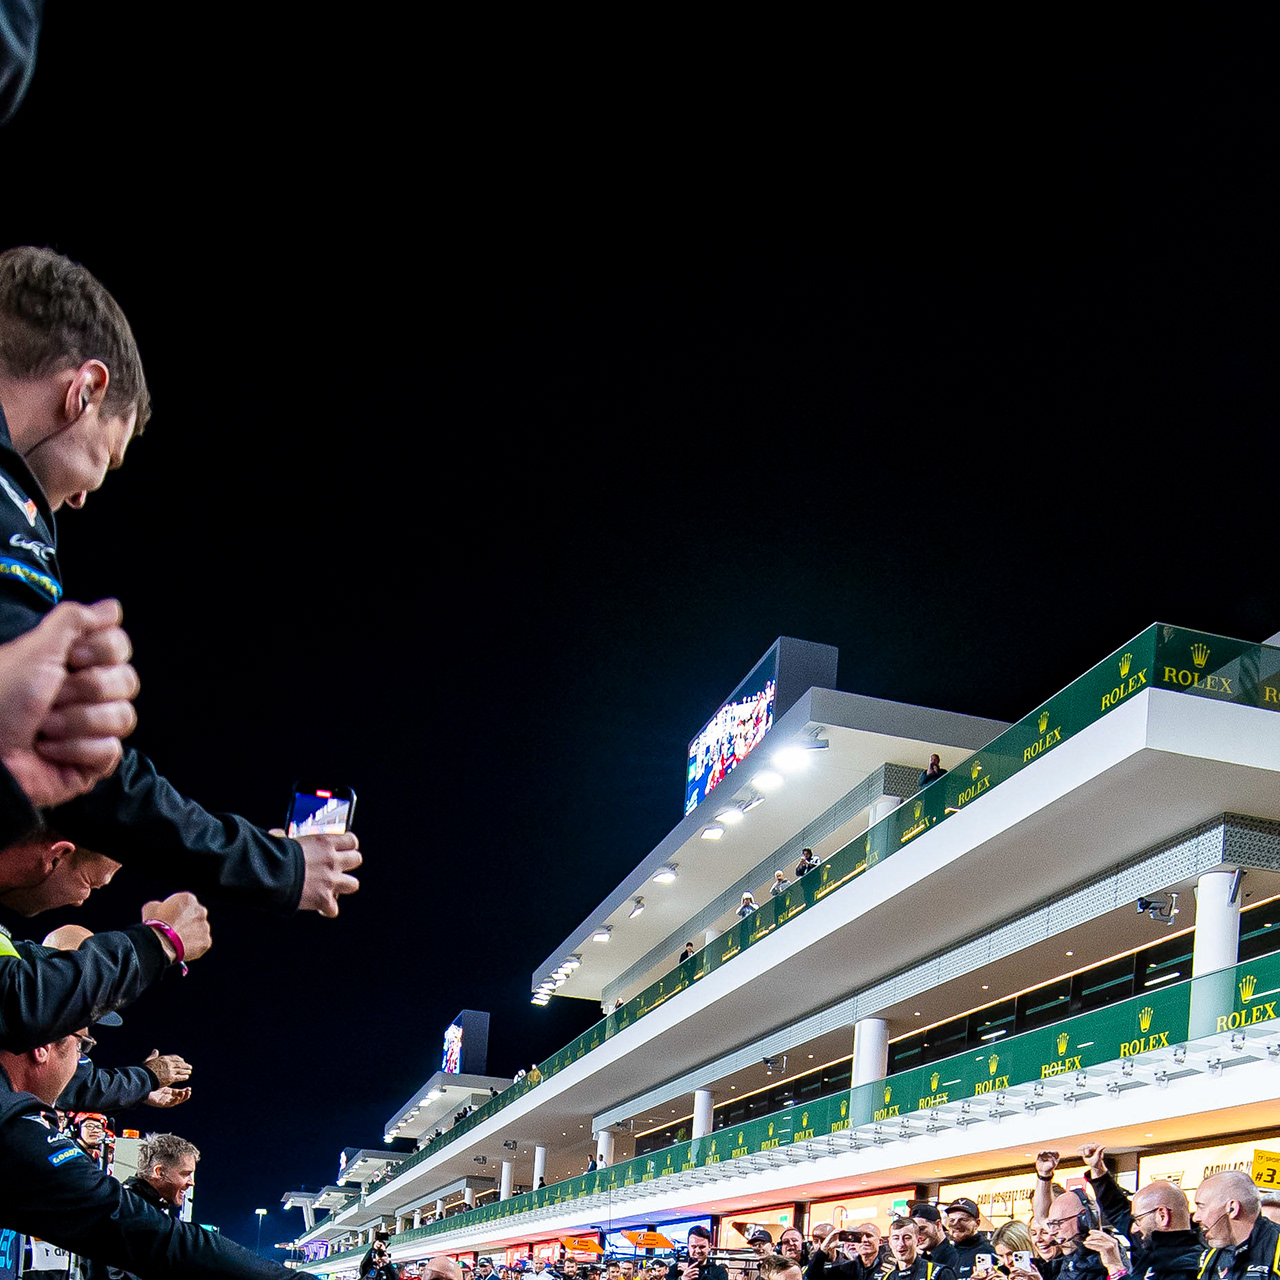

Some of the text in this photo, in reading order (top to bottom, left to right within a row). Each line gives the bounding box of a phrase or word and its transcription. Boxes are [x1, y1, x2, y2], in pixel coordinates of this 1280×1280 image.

[1100, 667, 1148, 712] ROLEX
[1163, 667, 1233, 695] ROLEX
[1023, 726, 1062, 763] ROLEX
[958, 775, 991, 808] ROLEX
[1216, 1001, 1277, 1034] ROLEX
[1120, 1031, 1170, 1059] ROLEX
[1041, 1055, 1082, 1079] ROLEX
[975, 1075, 1010, 1096] ROLEX
[919, 1092, 949, 1110] ROLEX
[831, 1118, 854, 1133] ROLEX
[874, 1105, 900, 1122] ROLEX
[761, 1138, 779, 1151] ROLEX
[794, 1128, 814, 1142] ROLEX
